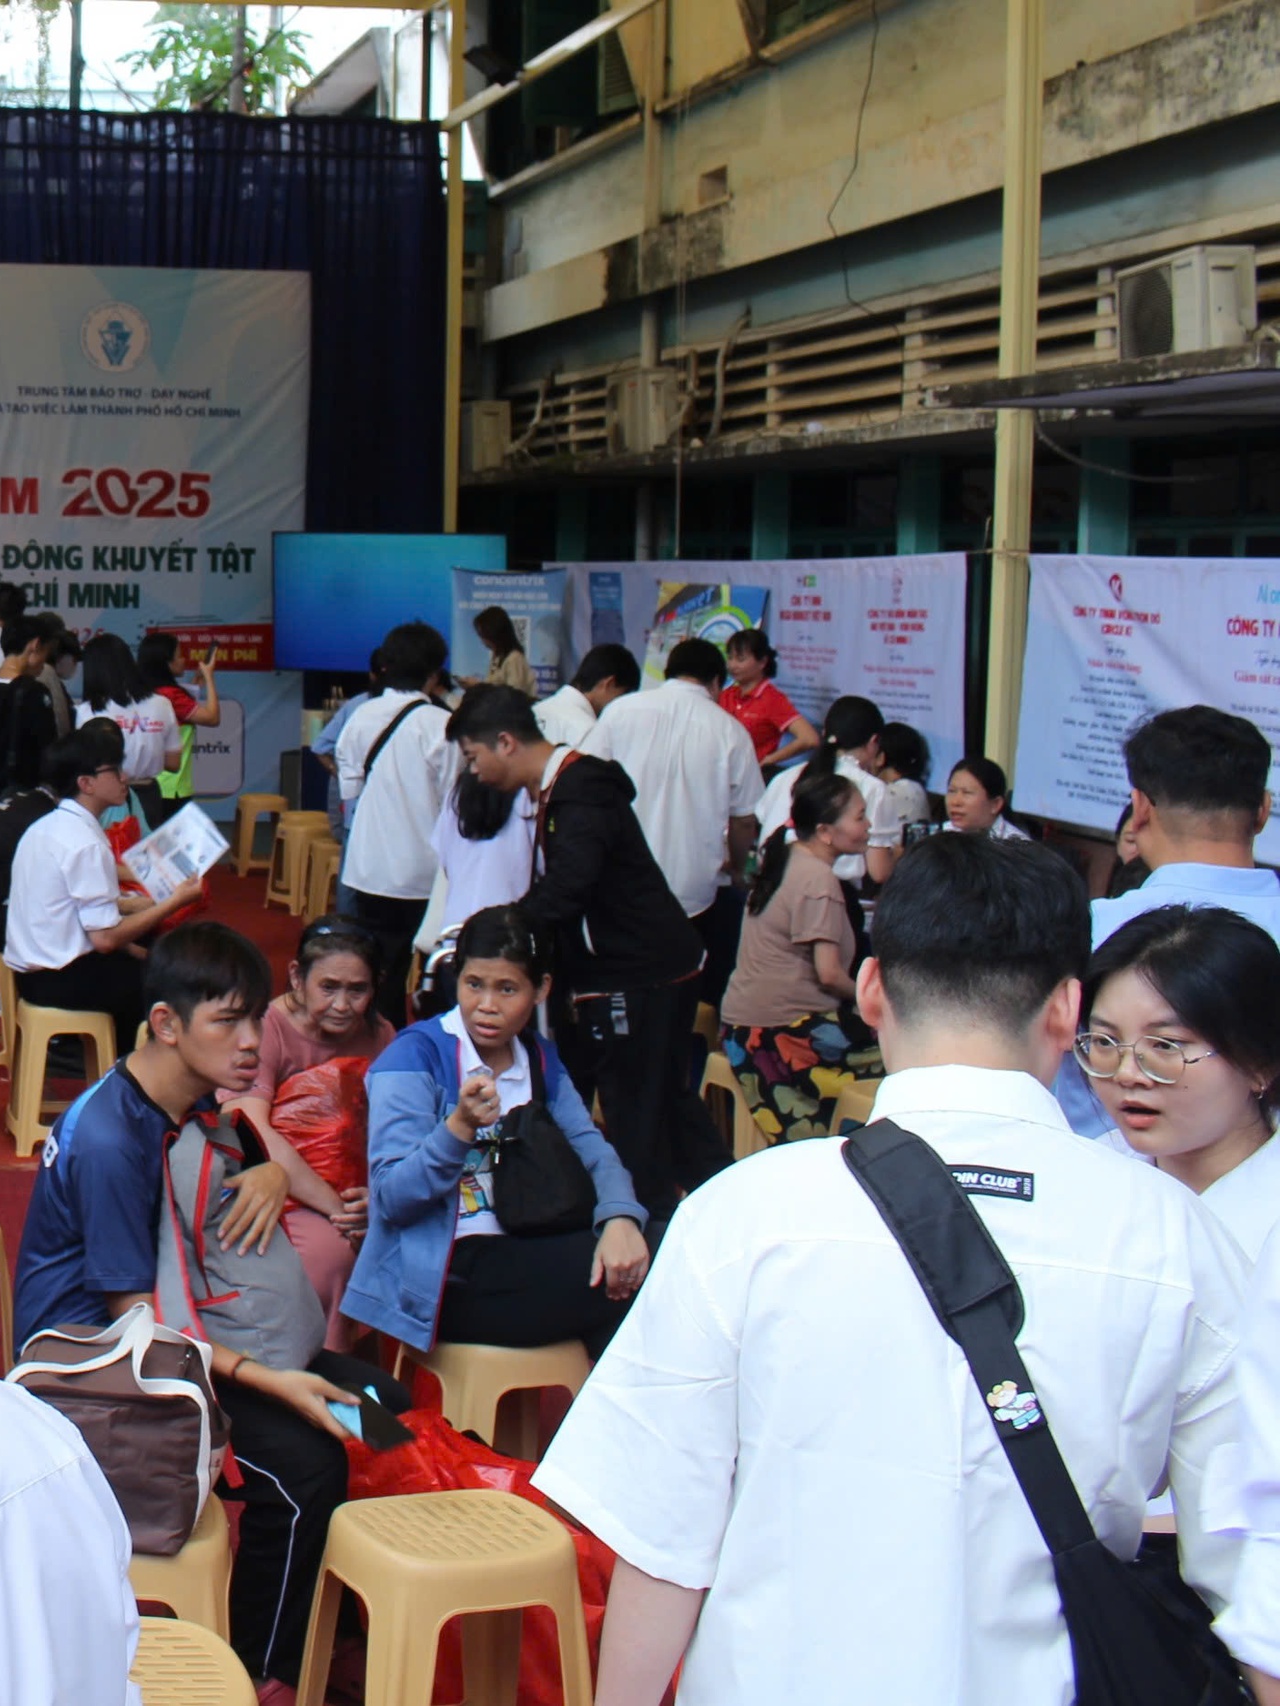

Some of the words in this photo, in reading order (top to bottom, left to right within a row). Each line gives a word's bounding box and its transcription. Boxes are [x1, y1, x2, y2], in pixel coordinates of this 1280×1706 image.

[17, 385, 59, 397] TRUNG
[62, 384, 88, 398] TÂM
[32, 402, 58, 416] VIỆC
[61, 402, 89, 415] LÀM
[90, 402, 134, 416] THÀNH
[185, 403, 206, 417] CHÍ
[208, 405, 241, 418] MINH
[60, 467, 211, 519] 2025
[1, 539, 83, 578] ĐỘNG
[93, 537, 198, 573] KHUYẾT
[206, 541, 257, 581] TẬT
[473, 573, 546, 586] concentrix
[68, 582, 141, 609] MINH
[1226, 615, 1259, 636] CÔNG
[1262, 619, 1275, 637] TY
